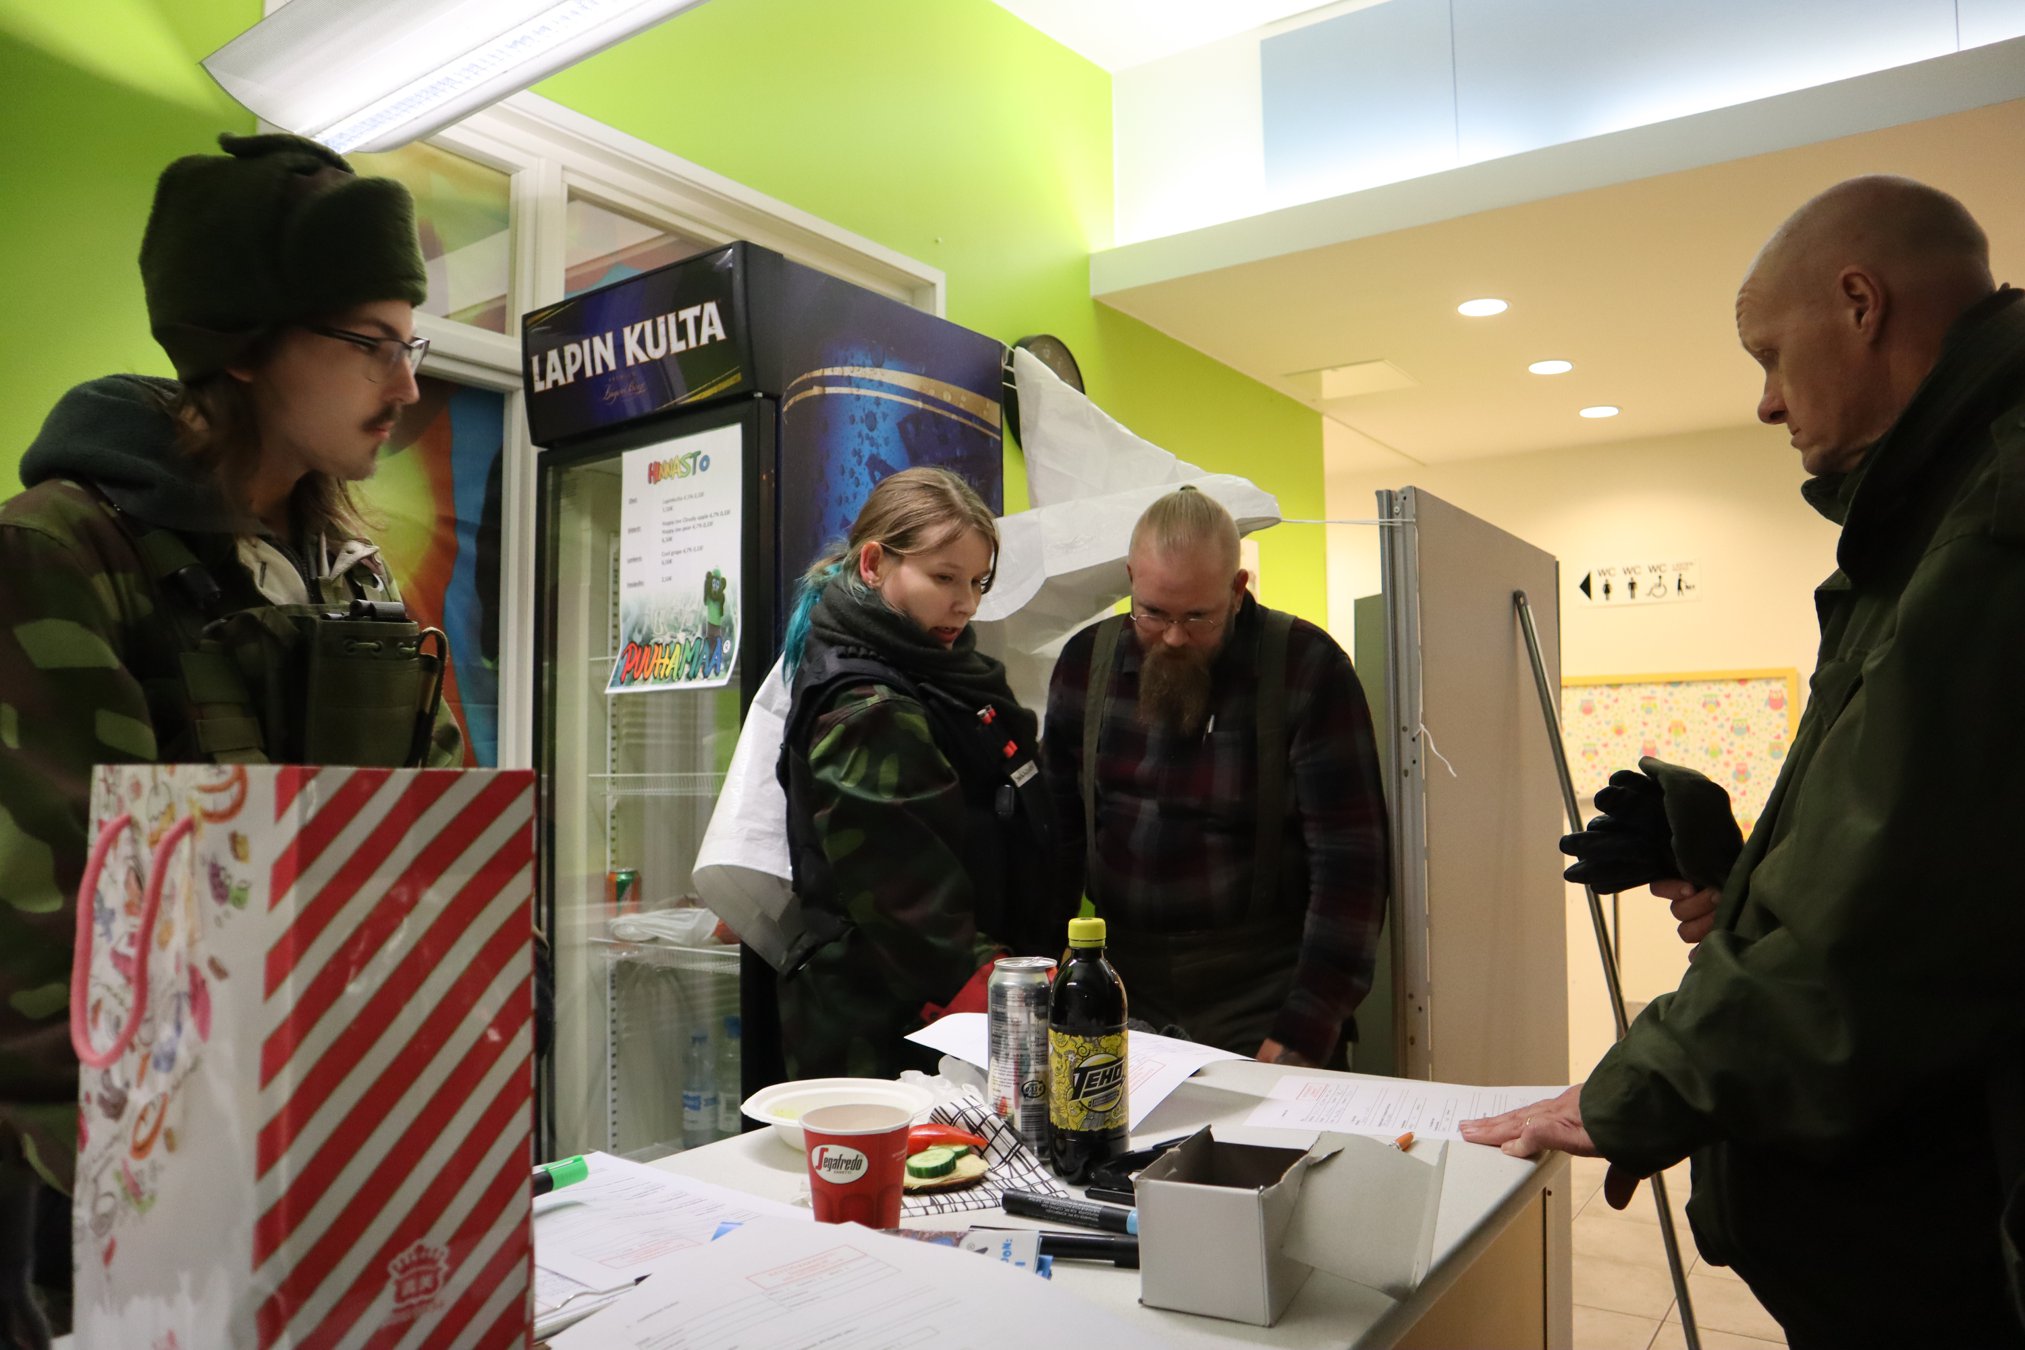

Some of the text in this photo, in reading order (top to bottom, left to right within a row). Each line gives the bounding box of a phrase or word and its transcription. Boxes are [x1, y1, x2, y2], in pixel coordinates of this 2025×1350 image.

[531, 300, 727, 394] LAPIN KULTA
[648, 450, 710, 484] HINNASTO
[1597, 566, 1616, 578] WC
[1622, 564, 1642, 576] WC
[1647, 562, 1668, 575] WC
[620, 636, 723, 684] PUUHAMAA
[1070, 1056, 1124, 1102] TEHO
[815, 1147, 863, 1173] Segafredo
